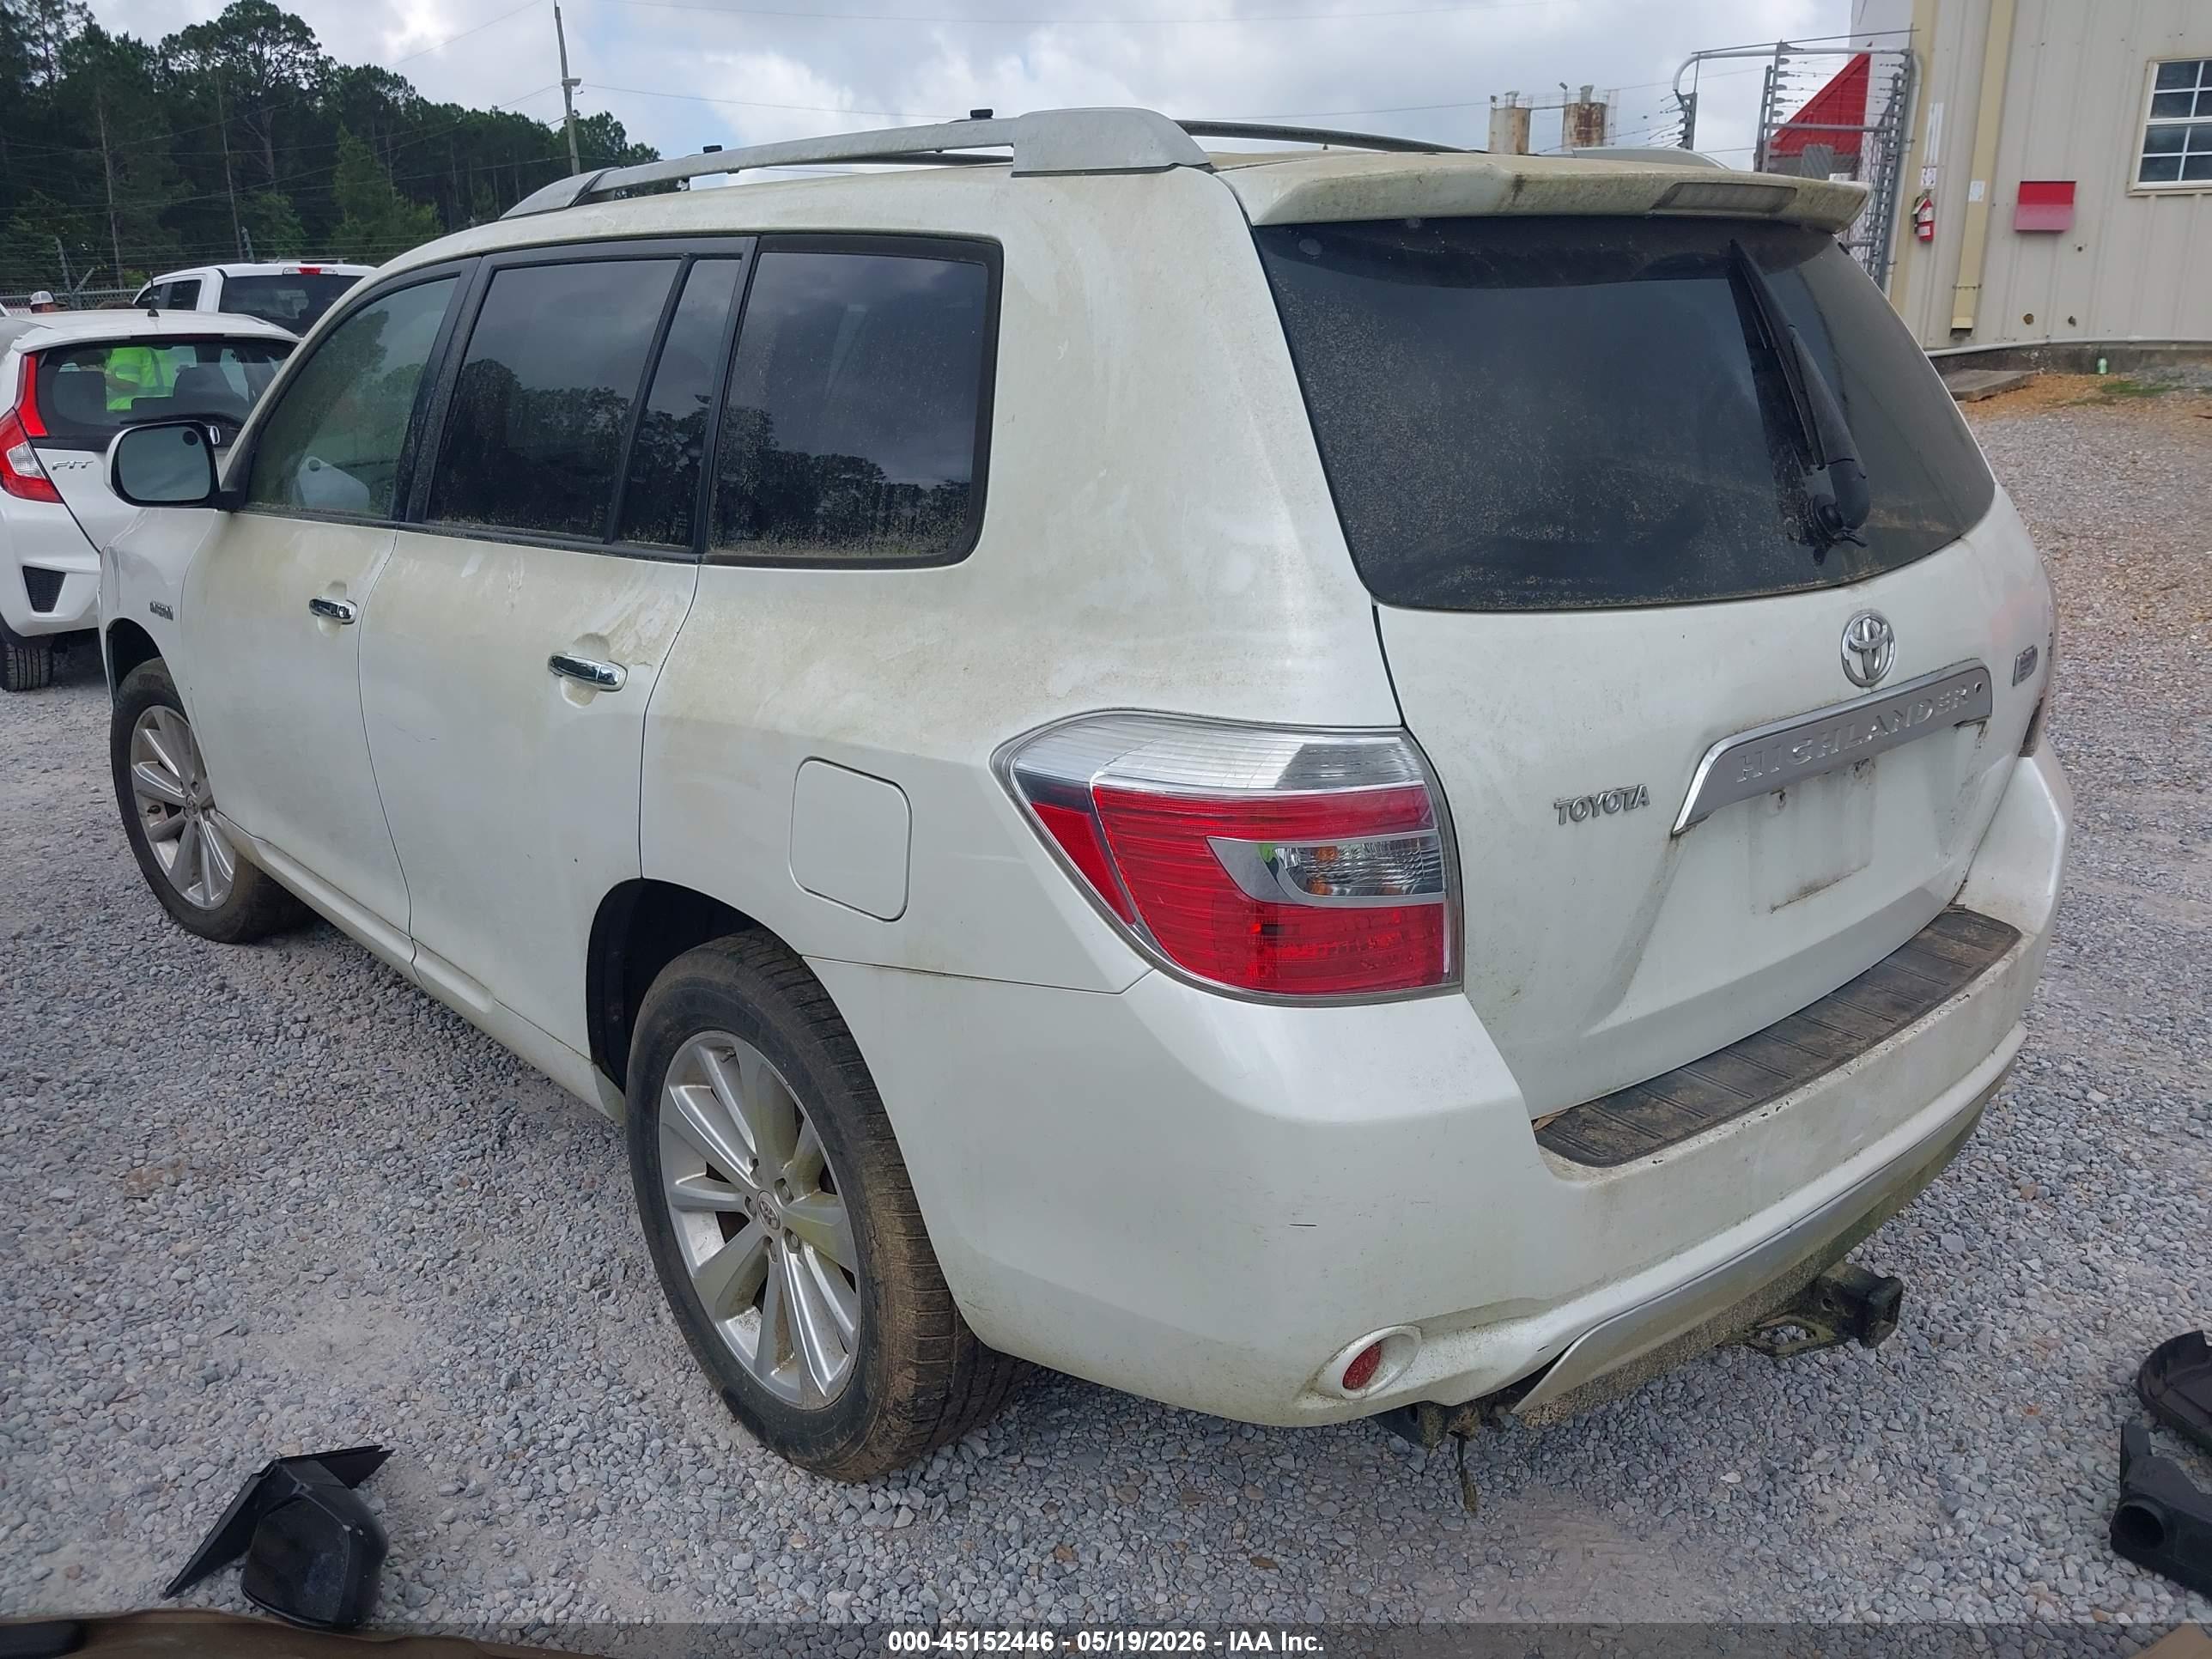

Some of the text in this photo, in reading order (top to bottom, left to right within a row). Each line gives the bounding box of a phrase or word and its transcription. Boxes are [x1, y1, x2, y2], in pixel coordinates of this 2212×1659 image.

[52, 460, 94, 471] FIT
[1735, 684, 1968, 783] HIGHLANDER
[1553, 783, 1650, 825] TOYOTA
